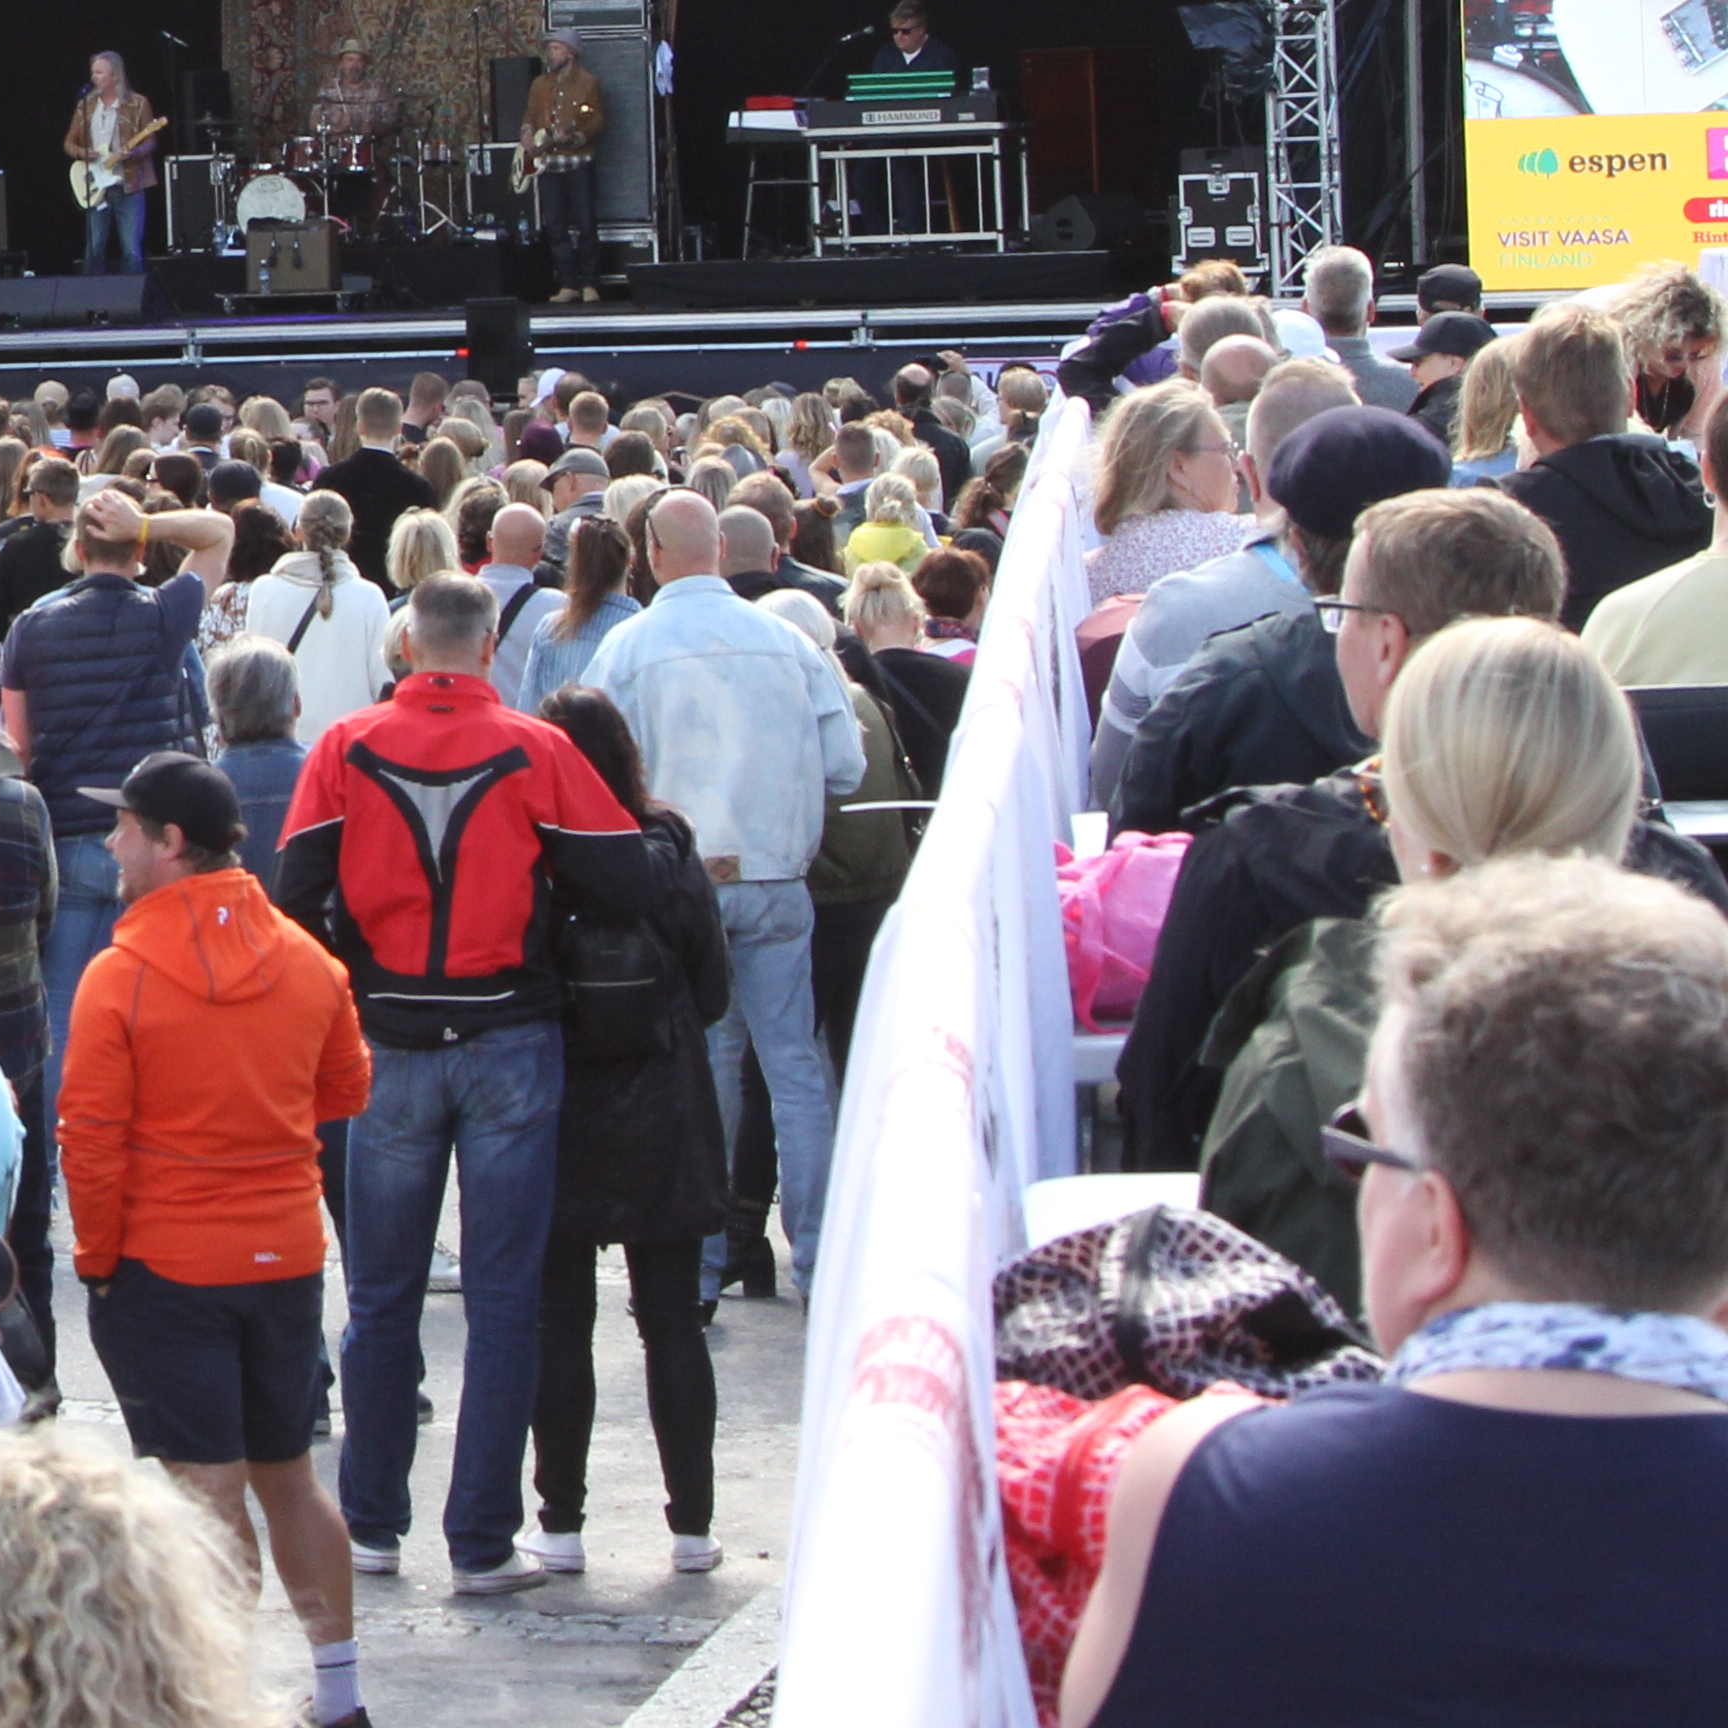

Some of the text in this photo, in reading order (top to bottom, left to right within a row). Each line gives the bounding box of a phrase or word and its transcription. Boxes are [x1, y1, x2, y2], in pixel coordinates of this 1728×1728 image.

[877, 111, 938, 122] HAMMOND
[1568, 152, 1669, 178] espen
[1498, 229, 1631, 247] VISIT VAASA
[1499, 251, 1593, 268] FINLAND
